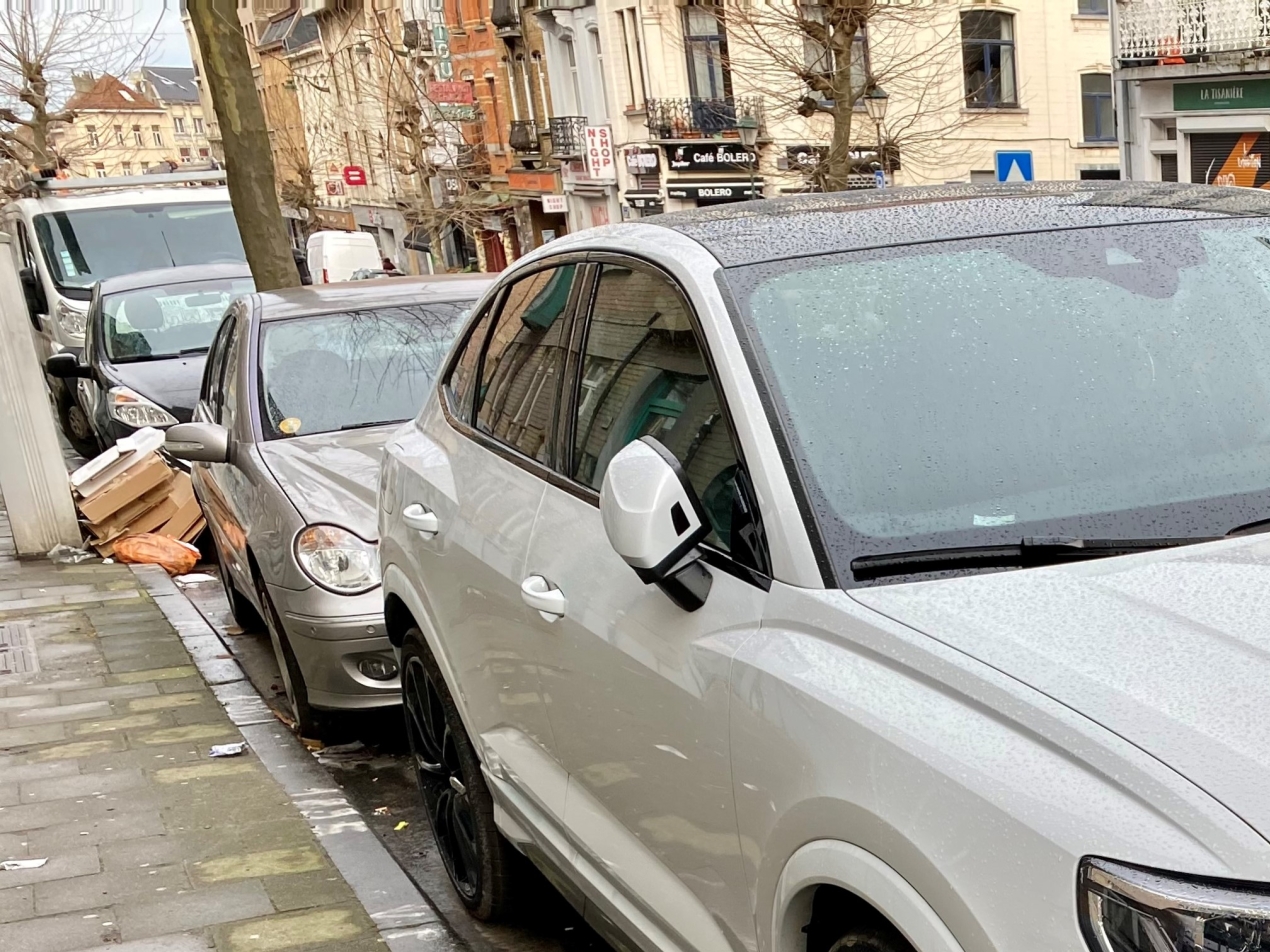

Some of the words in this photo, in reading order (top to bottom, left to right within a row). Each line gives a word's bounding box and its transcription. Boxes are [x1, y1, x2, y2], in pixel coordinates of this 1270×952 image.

[1200, 89, 1209, 100] LA
[1211, 86, 1244, 99] TISANIÈRE
[587, 128, 601, 177] NIGHT
[598, 128, 611, 168] SHOP
[693, 152, 714, 162] Café
[698, 188, 732, 197] BOLERO
